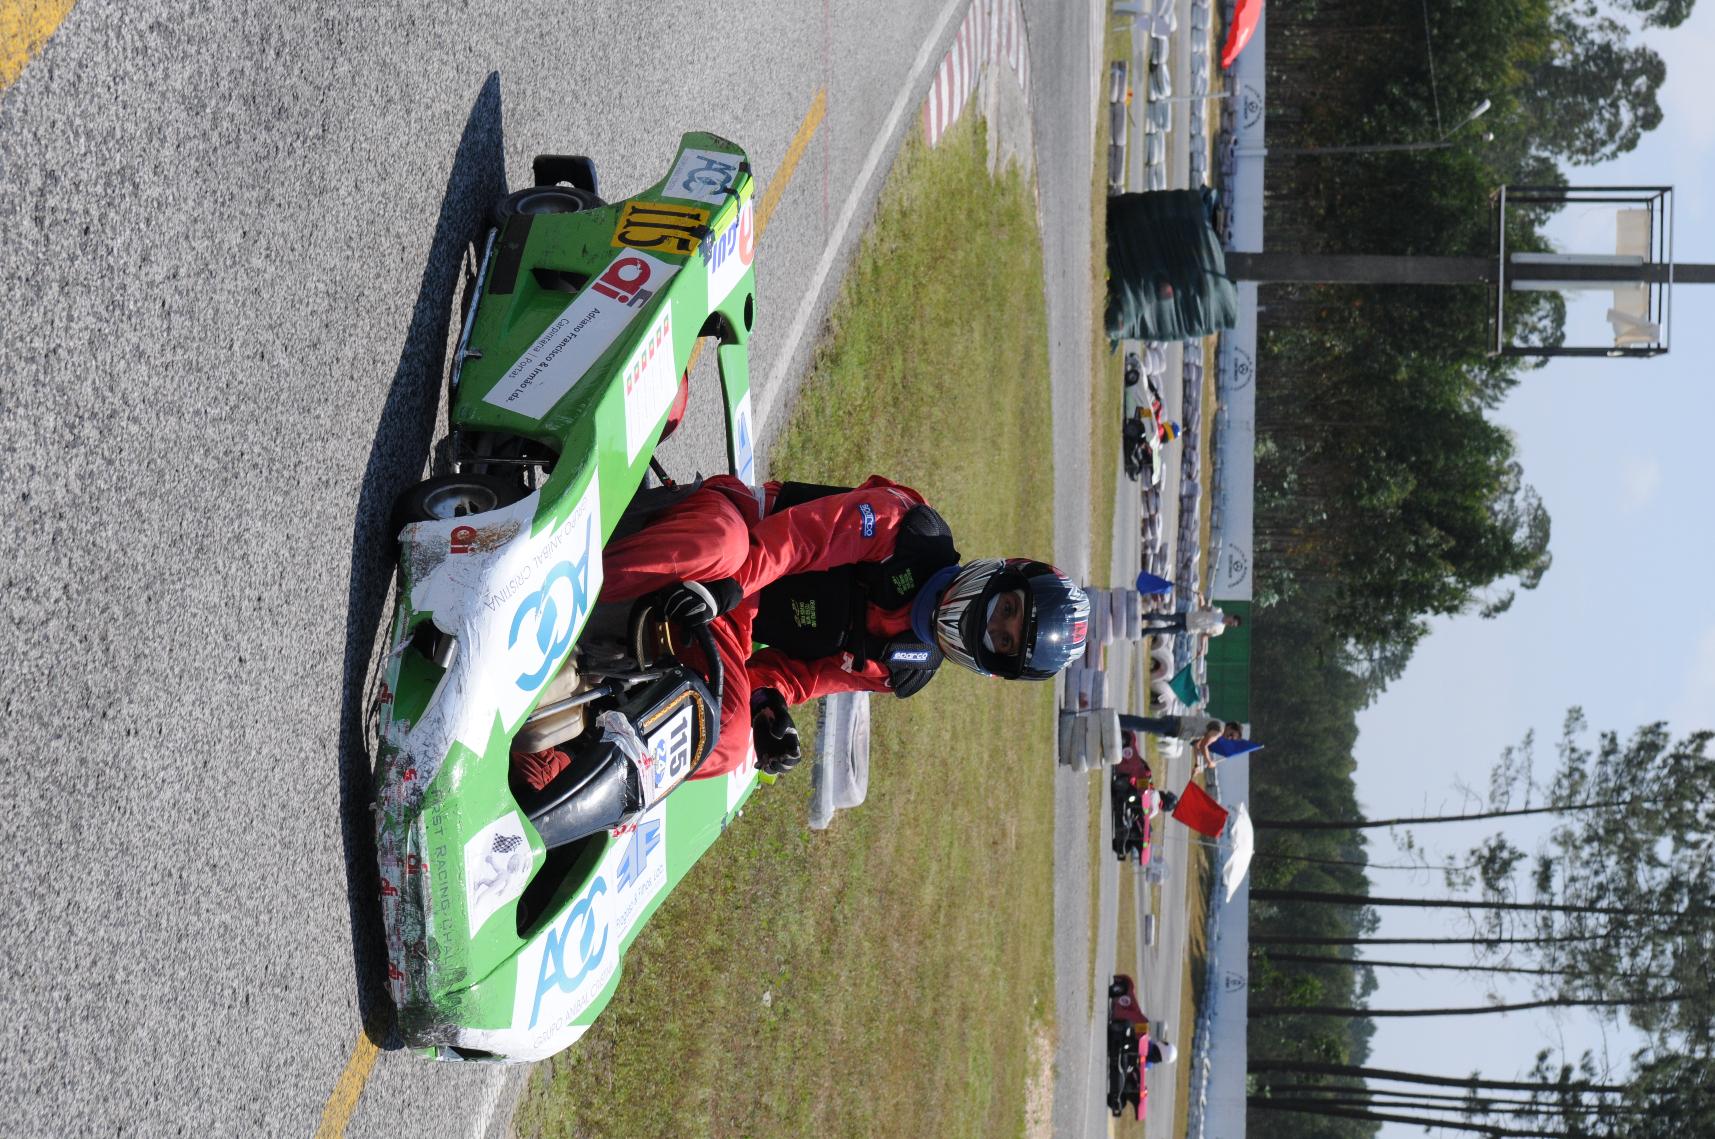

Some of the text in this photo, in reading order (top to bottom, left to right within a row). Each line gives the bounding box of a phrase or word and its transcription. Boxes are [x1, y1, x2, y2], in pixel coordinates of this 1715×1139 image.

[618, 206, 702, 252] 115
[533, 318, 569, 352] Carpintaria
[574, 308, 600, 333] Adriano
[545, 332, 577, 362] Francisco
[508, 357, 533, 379] Portas
[520, 368, 542, 389] Irmão
[860, 504, 874, 537] sparco
[484, 566, 532, 612] CRISTINA
[669, 717, 688, 778] 115
